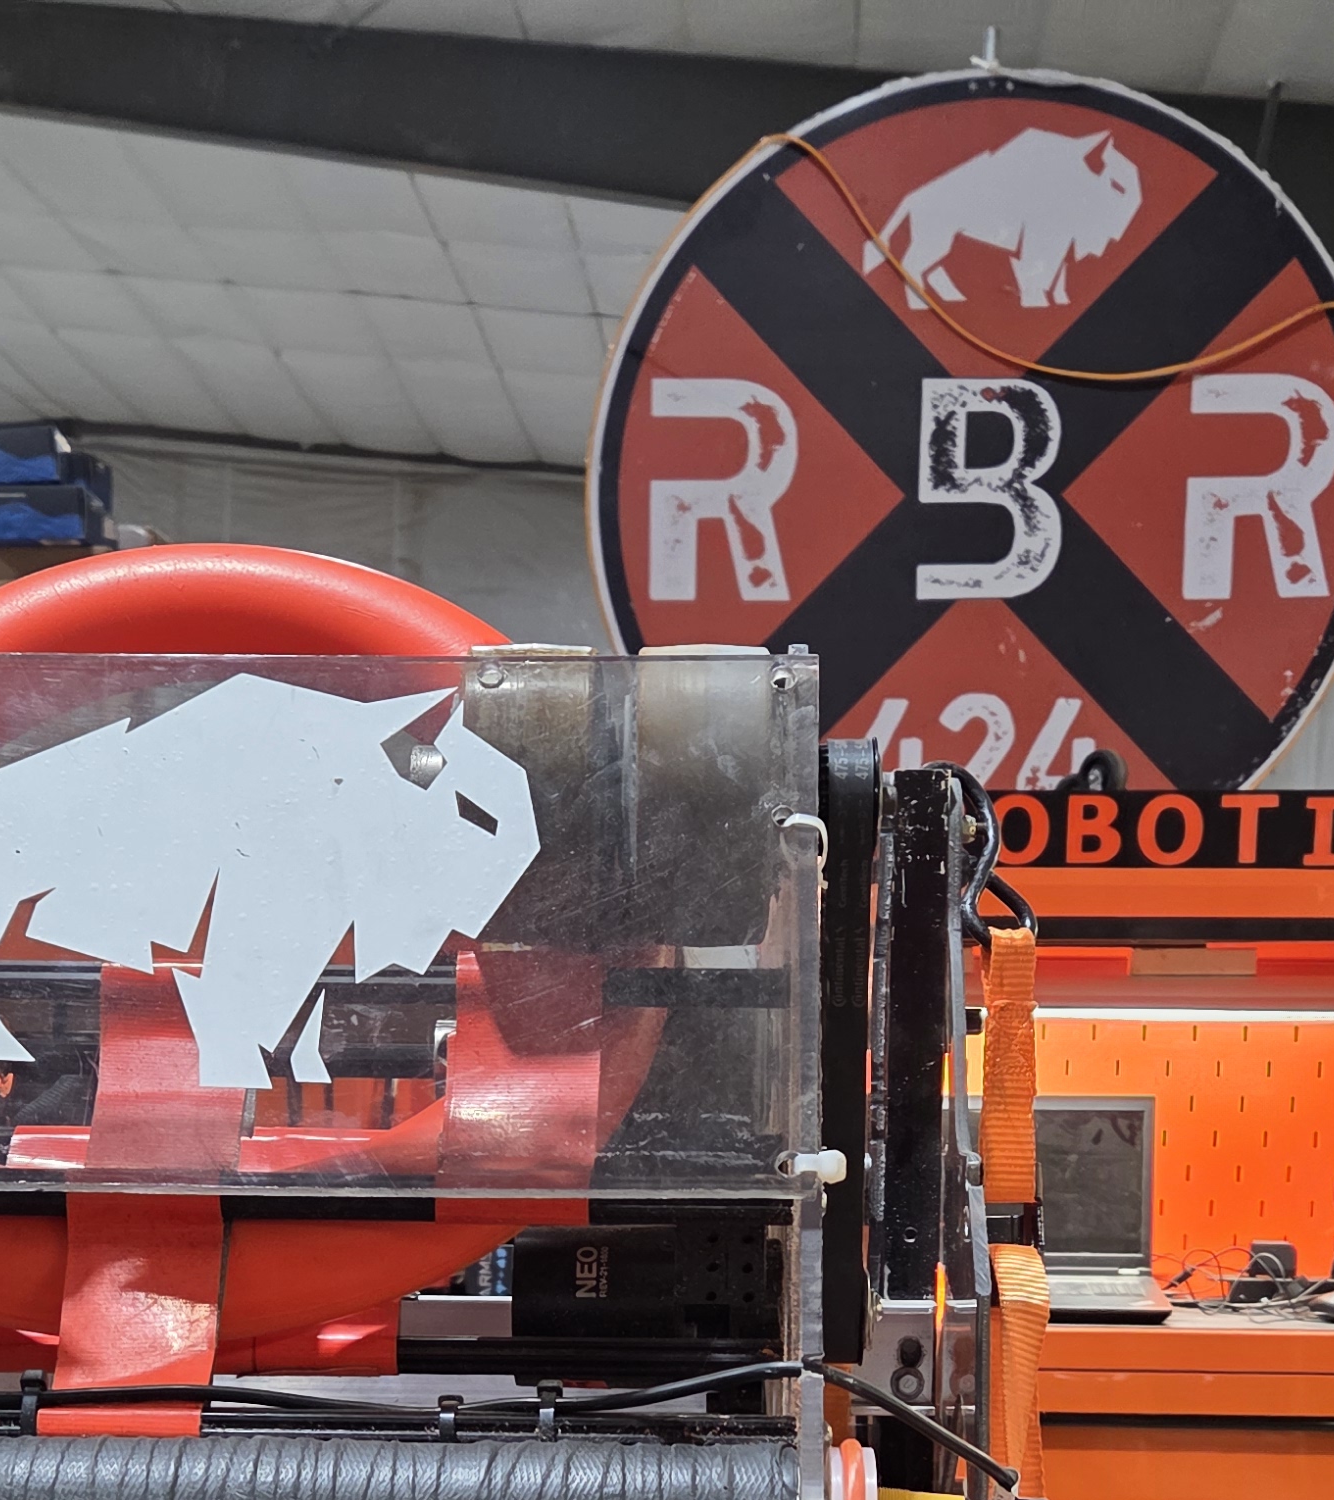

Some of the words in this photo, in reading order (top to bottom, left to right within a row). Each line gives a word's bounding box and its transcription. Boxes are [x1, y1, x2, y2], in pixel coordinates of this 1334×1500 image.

[649, 377, 799, 602] R
[916, 377, 1064, 602] B
[865, 691, 1097, 791] 424
[575, 1246, 599, 1299] NEO
